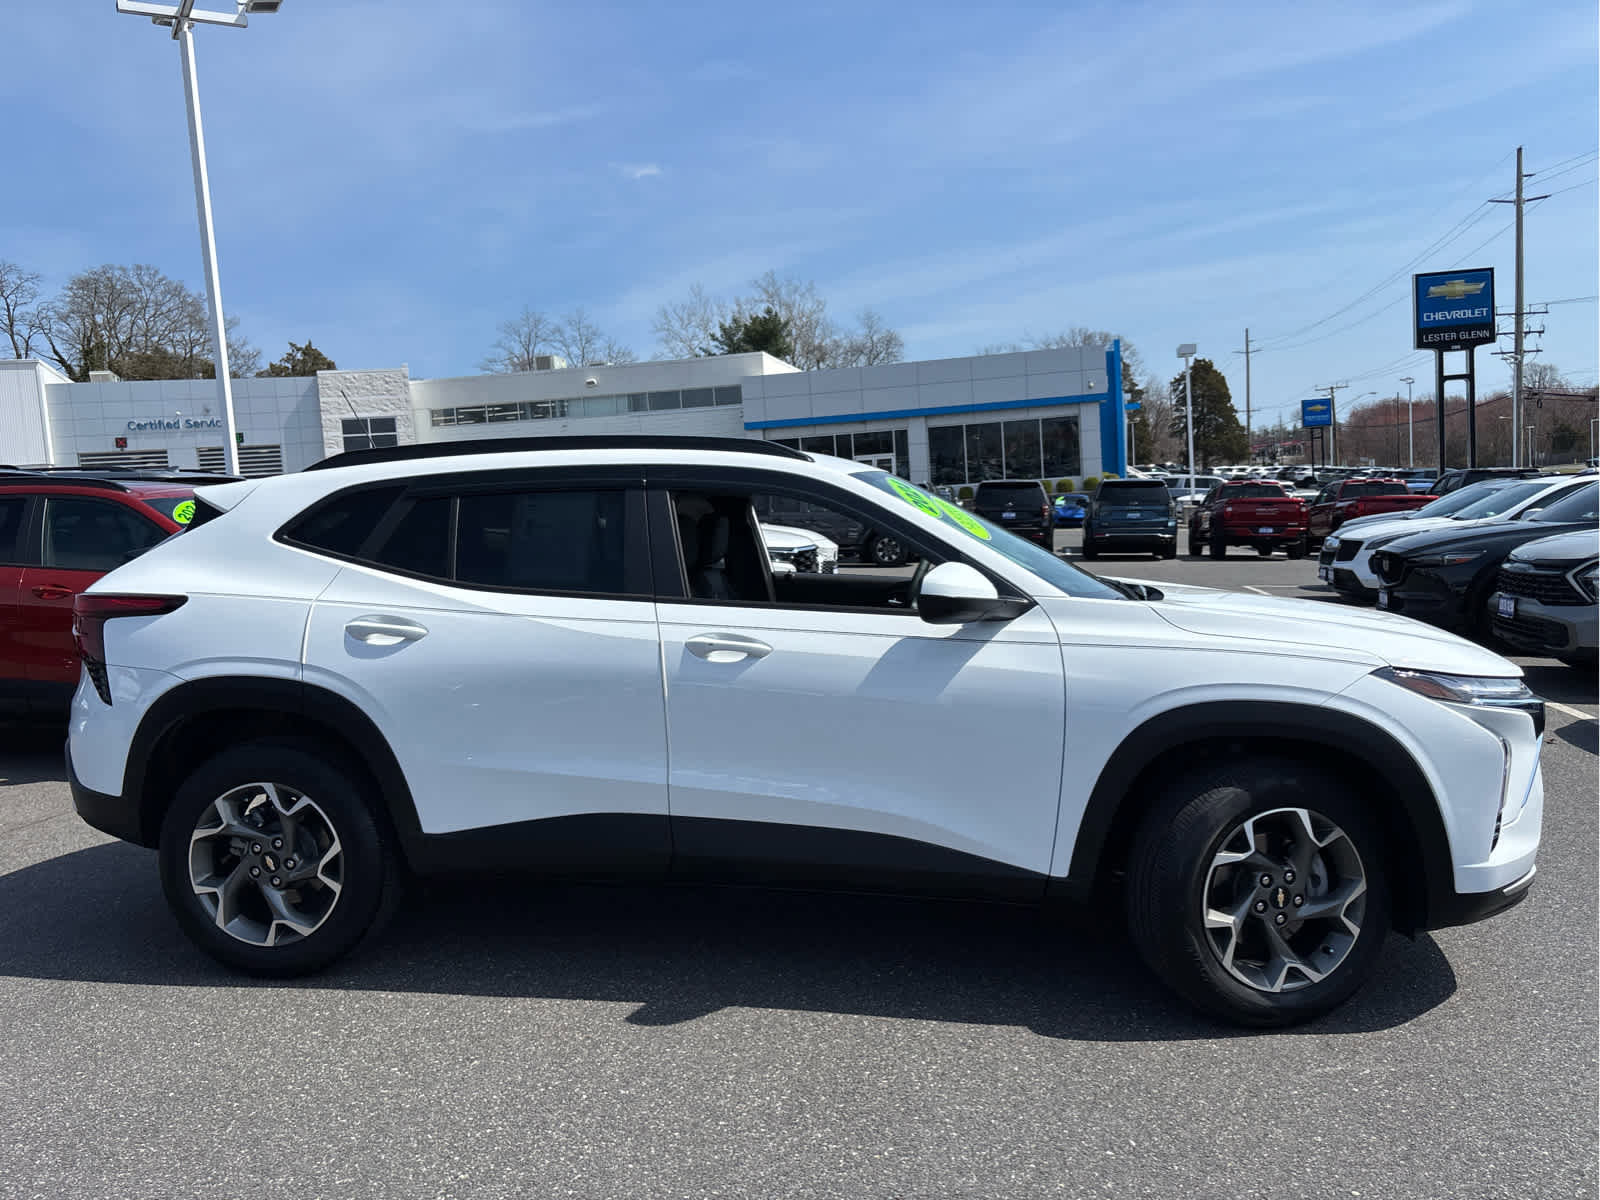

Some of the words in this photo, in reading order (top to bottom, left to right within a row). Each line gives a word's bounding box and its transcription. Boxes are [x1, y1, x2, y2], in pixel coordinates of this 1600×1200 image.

[1424, 308, 1488, 321] CHEVROLET
[1423, 332, 1457, 343] LESTER
[1459, 329, 1490, 340] GLENN
[127, 419, 180, 431] Certified
[184, 417, 223, 429] Servic
[178, 503, 195, 520] 202
